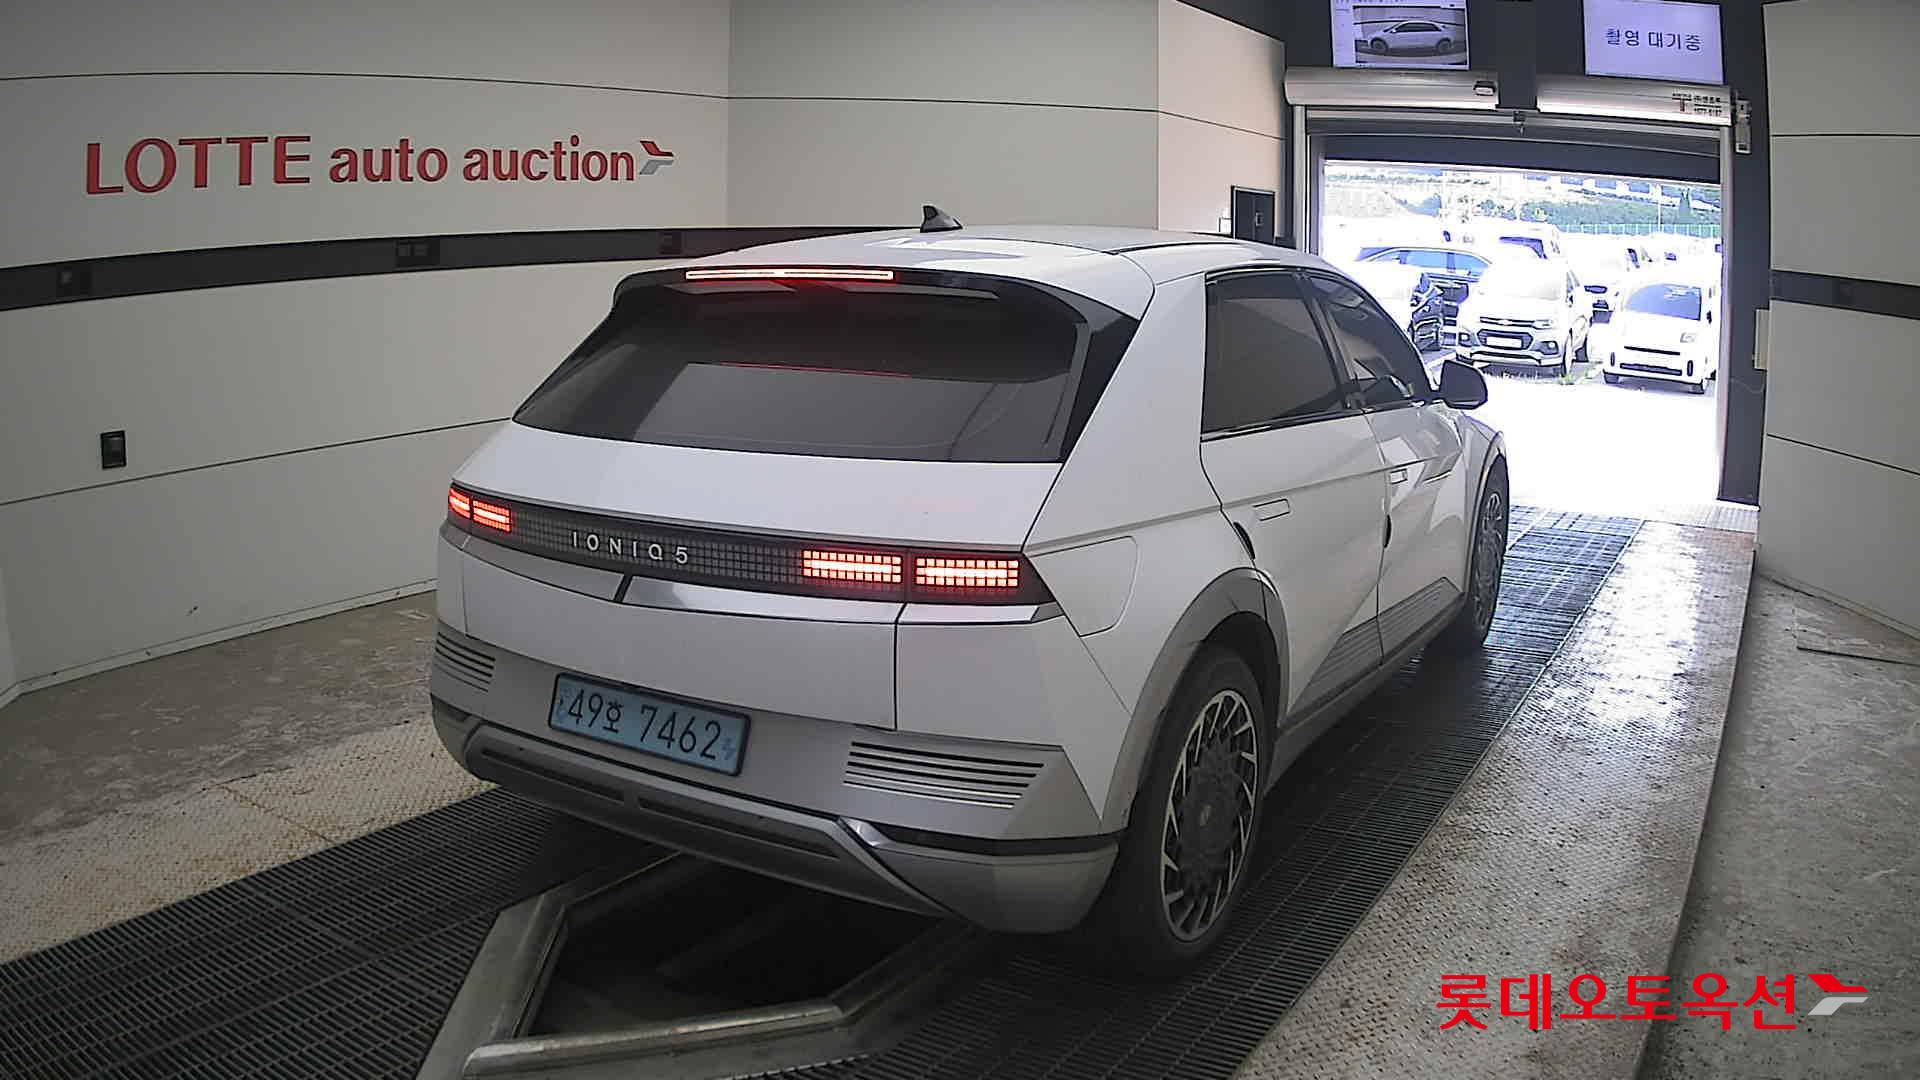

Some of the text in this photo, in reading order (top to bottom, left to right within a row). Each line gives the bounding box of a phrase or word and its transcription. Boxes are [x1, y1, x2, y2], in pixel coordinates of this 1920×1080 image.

[1648, 31, 1701, 51] 대기중
[86, 135, 634, 195] LOTTE auto auction
[640, 703, 721, 760] 7462
